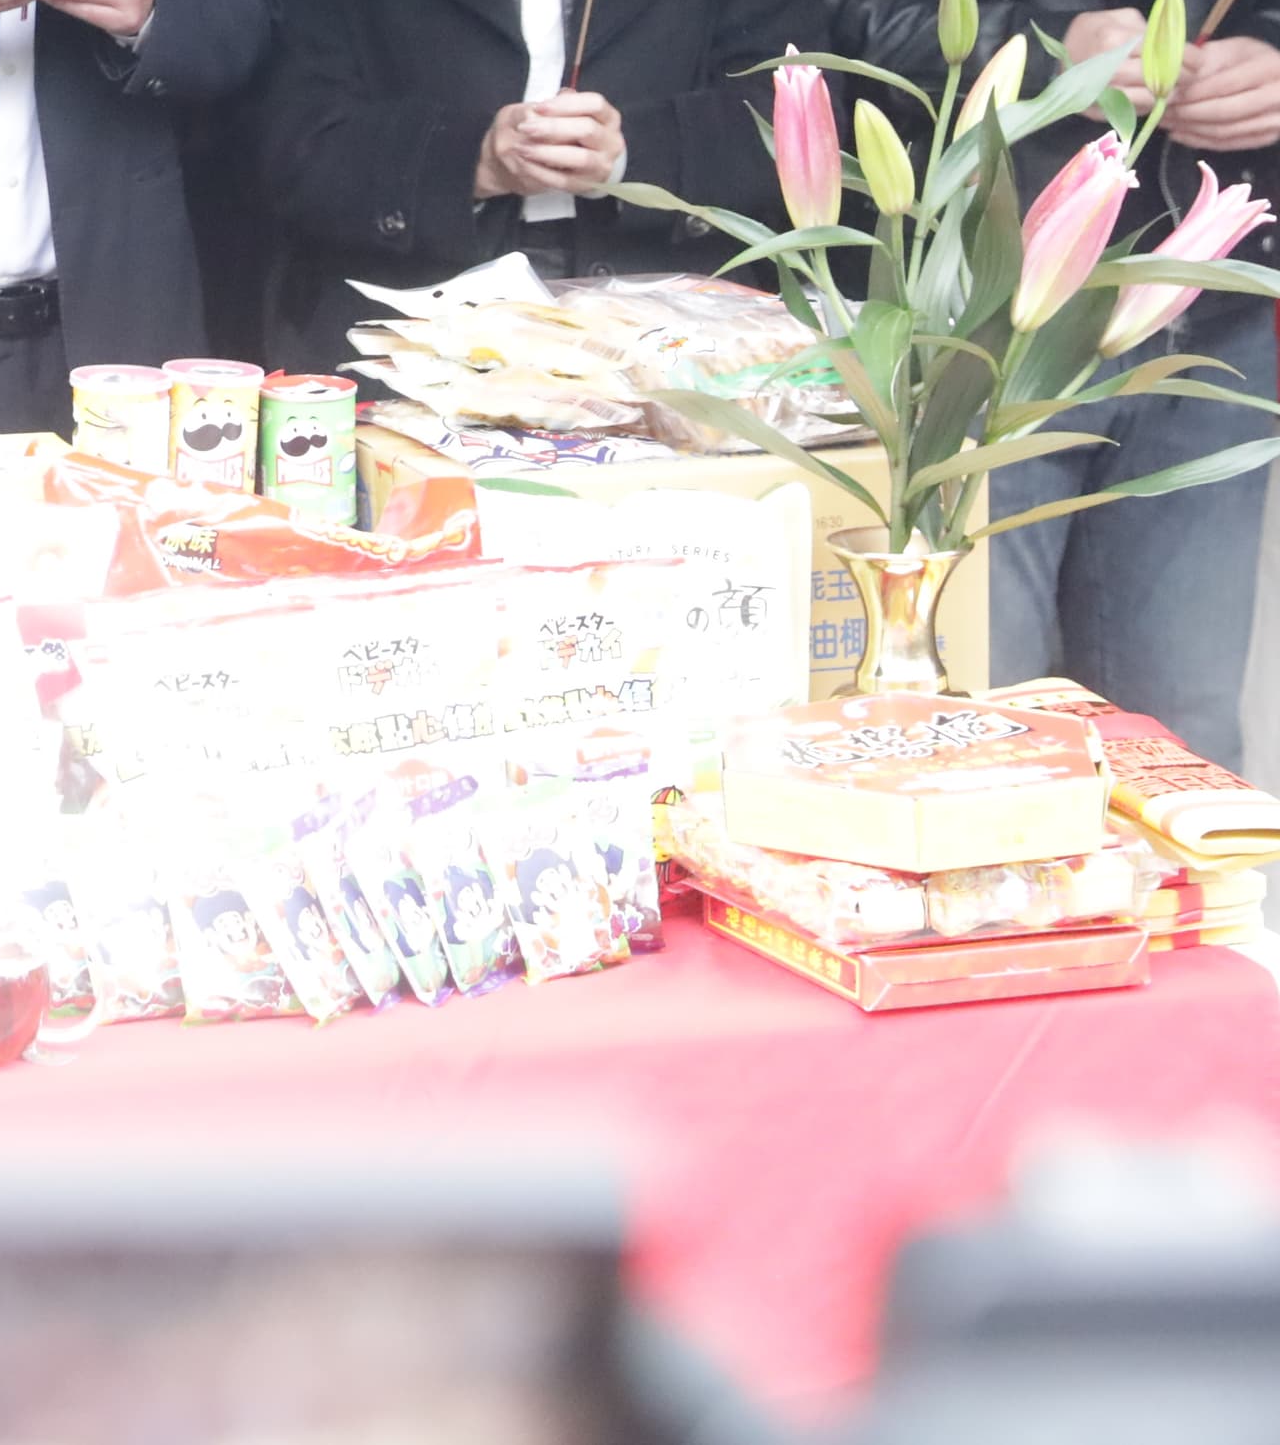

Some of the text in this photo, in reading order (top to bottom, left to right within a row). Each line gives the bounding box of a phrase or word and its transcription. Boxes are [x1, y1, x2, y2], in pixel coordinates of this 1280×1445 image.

[671, 543, 732, 563] SERIES
[538, 610, 616, 636] ベビースター
[342, 635, 432, 662] ベビースター
